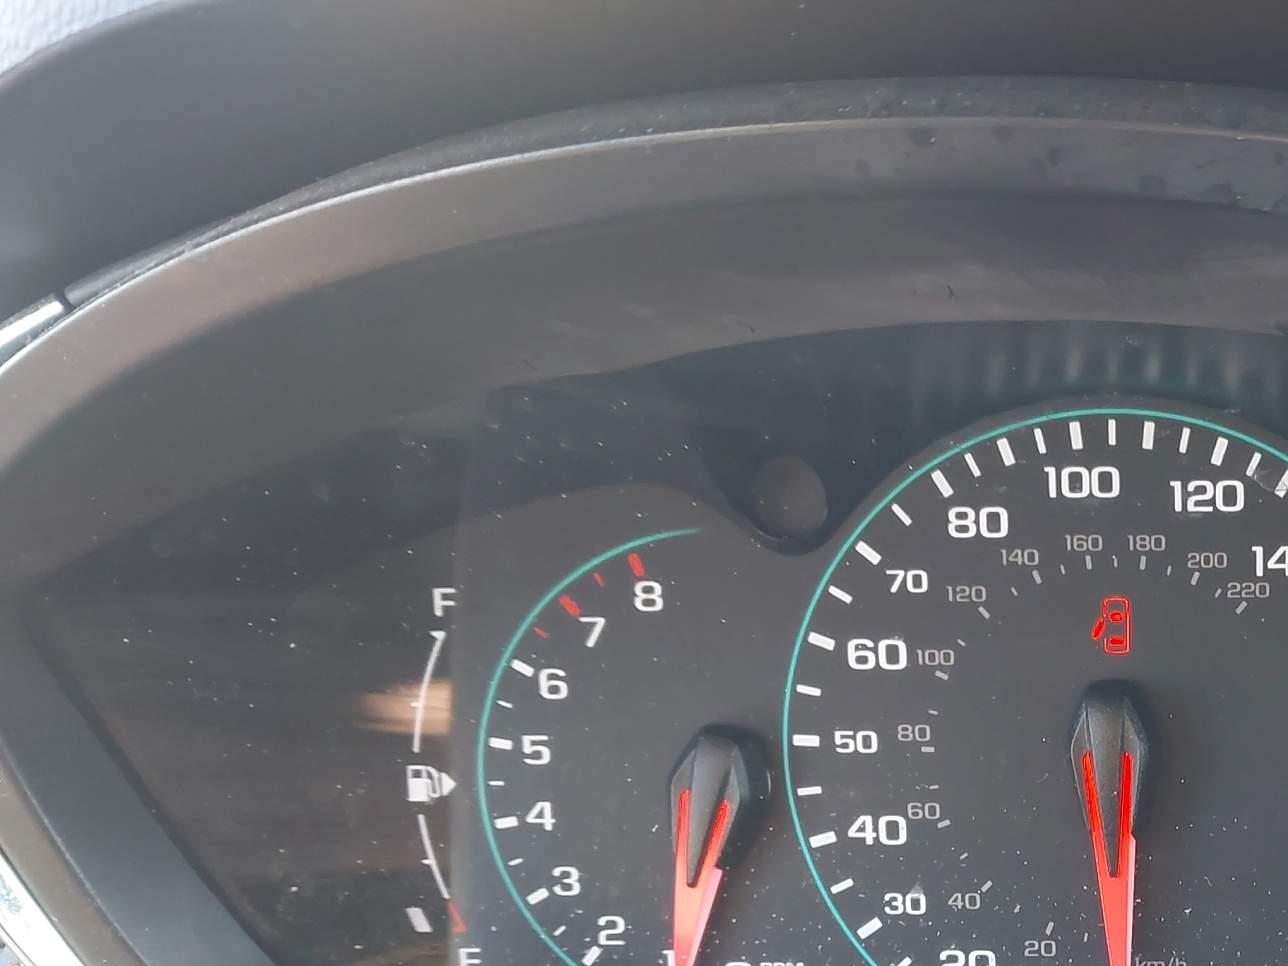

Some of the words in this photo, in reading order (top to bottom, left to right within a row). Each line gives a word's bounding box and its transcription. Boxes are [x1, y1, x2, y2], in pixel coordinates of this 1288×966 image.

[1044, 466, 1121, 499] 100
[1170, 480, 1245, 513] 120
[947, 506, 1009, 538] 80
[1065, 534, 1103, 552] 160
[1127, 534, 1166, 552] 180
[1001, 548, 1039, 566] 140
[1187, 552, 1227, 569] 200
[886, 570, 928, 593] 70
[1227, 582, 1270, 599] 220
[432, 588, 457, 616] F
[633, 581, 664, 612] 8
[946, 585, 987, 603] 120
[580, 617, 606, 647] 7
[847, 639, 908, 671] 60
[916, 648, 955, 666] 100
[537, 668, 569, 700] 6
[833, 730, 878, 754] 50
[897, 725, 931, 742] 80
[521, 735, 552, 765] 5
[525, 802, 556, 831] 4
[907, 802, 941, 820] 60
[847, 815, 908, 846] 40
[552, 866, 581, 897] 3
[883, 892, 927, 915] 30
[948, 892, 981, 910] 40
[597, 915, 626, 946] 2
[1024, 940, 1057, 957] 20
